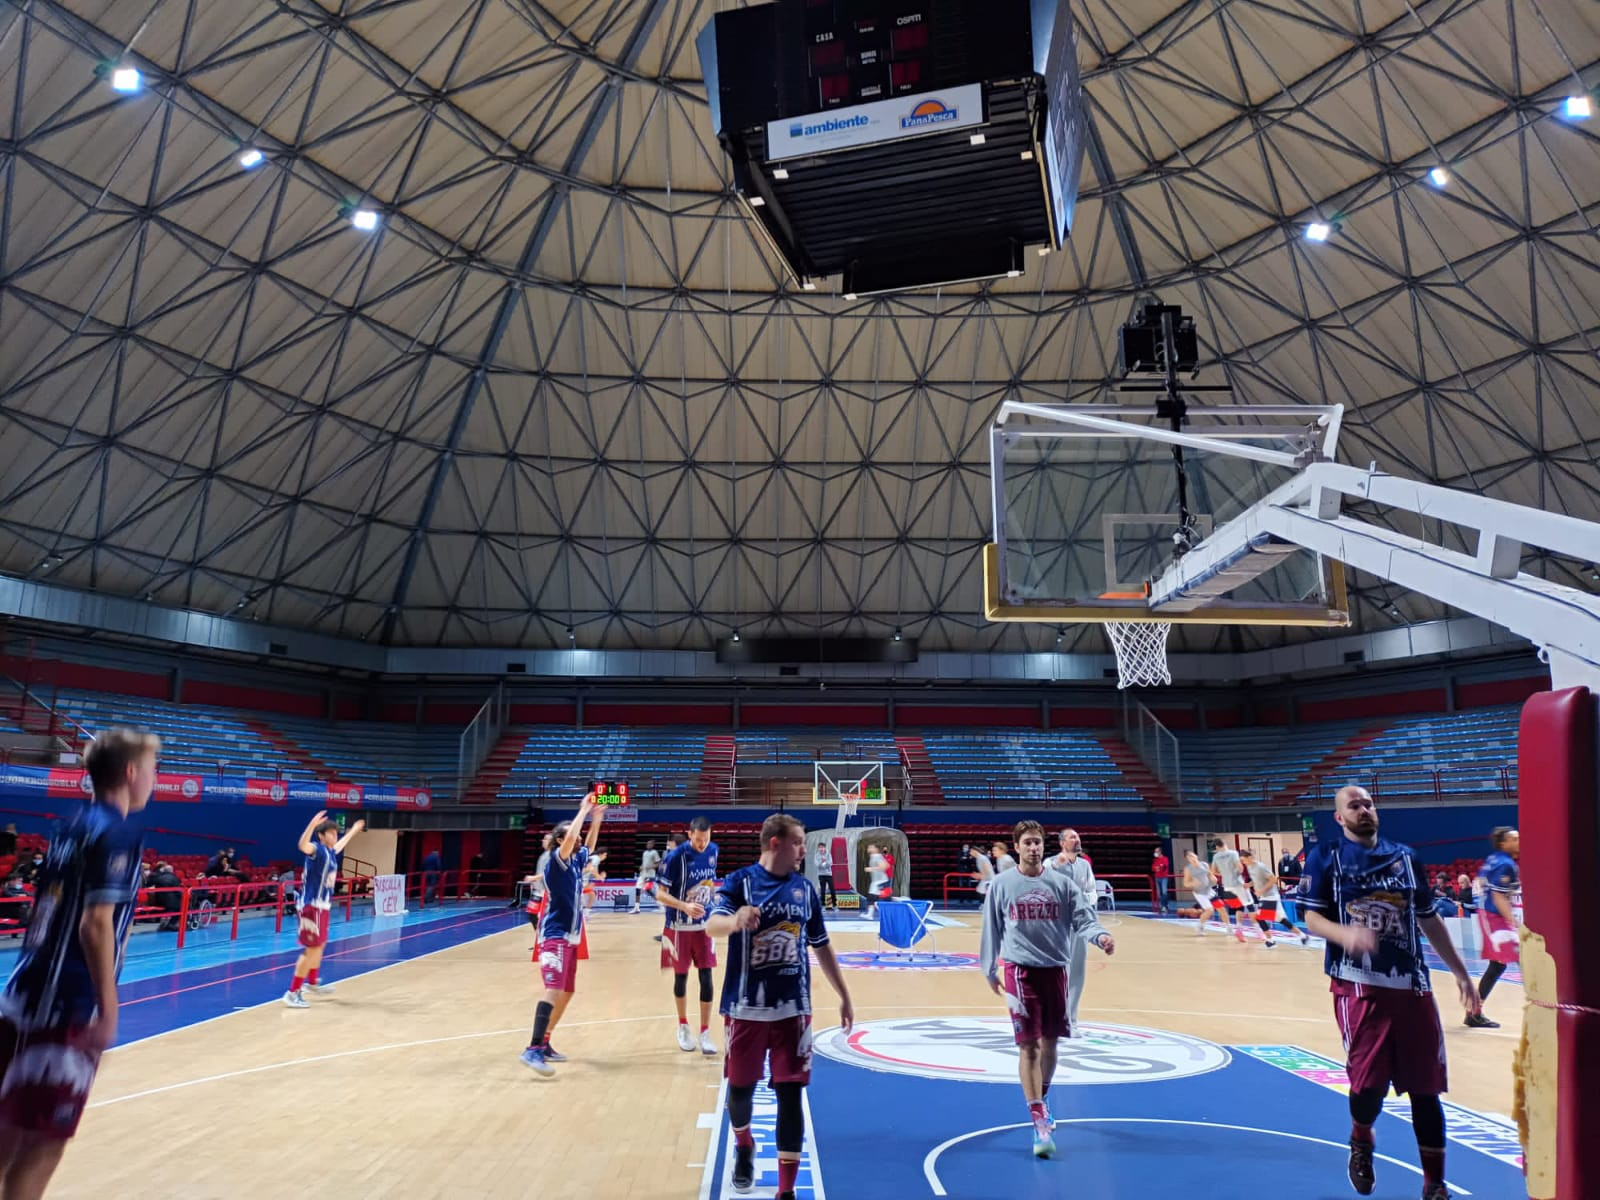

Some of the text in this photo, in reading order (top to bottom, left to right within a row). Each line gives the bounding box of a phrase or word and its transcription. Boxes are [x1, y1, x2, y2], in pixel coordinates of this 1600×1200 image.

[815, 32, 834, 43] CASA
[804, 114, 869, 135] ambiente
[597, 794, 620, 804] 20:00
[1009, 902, 1060, 921] AREZZO
